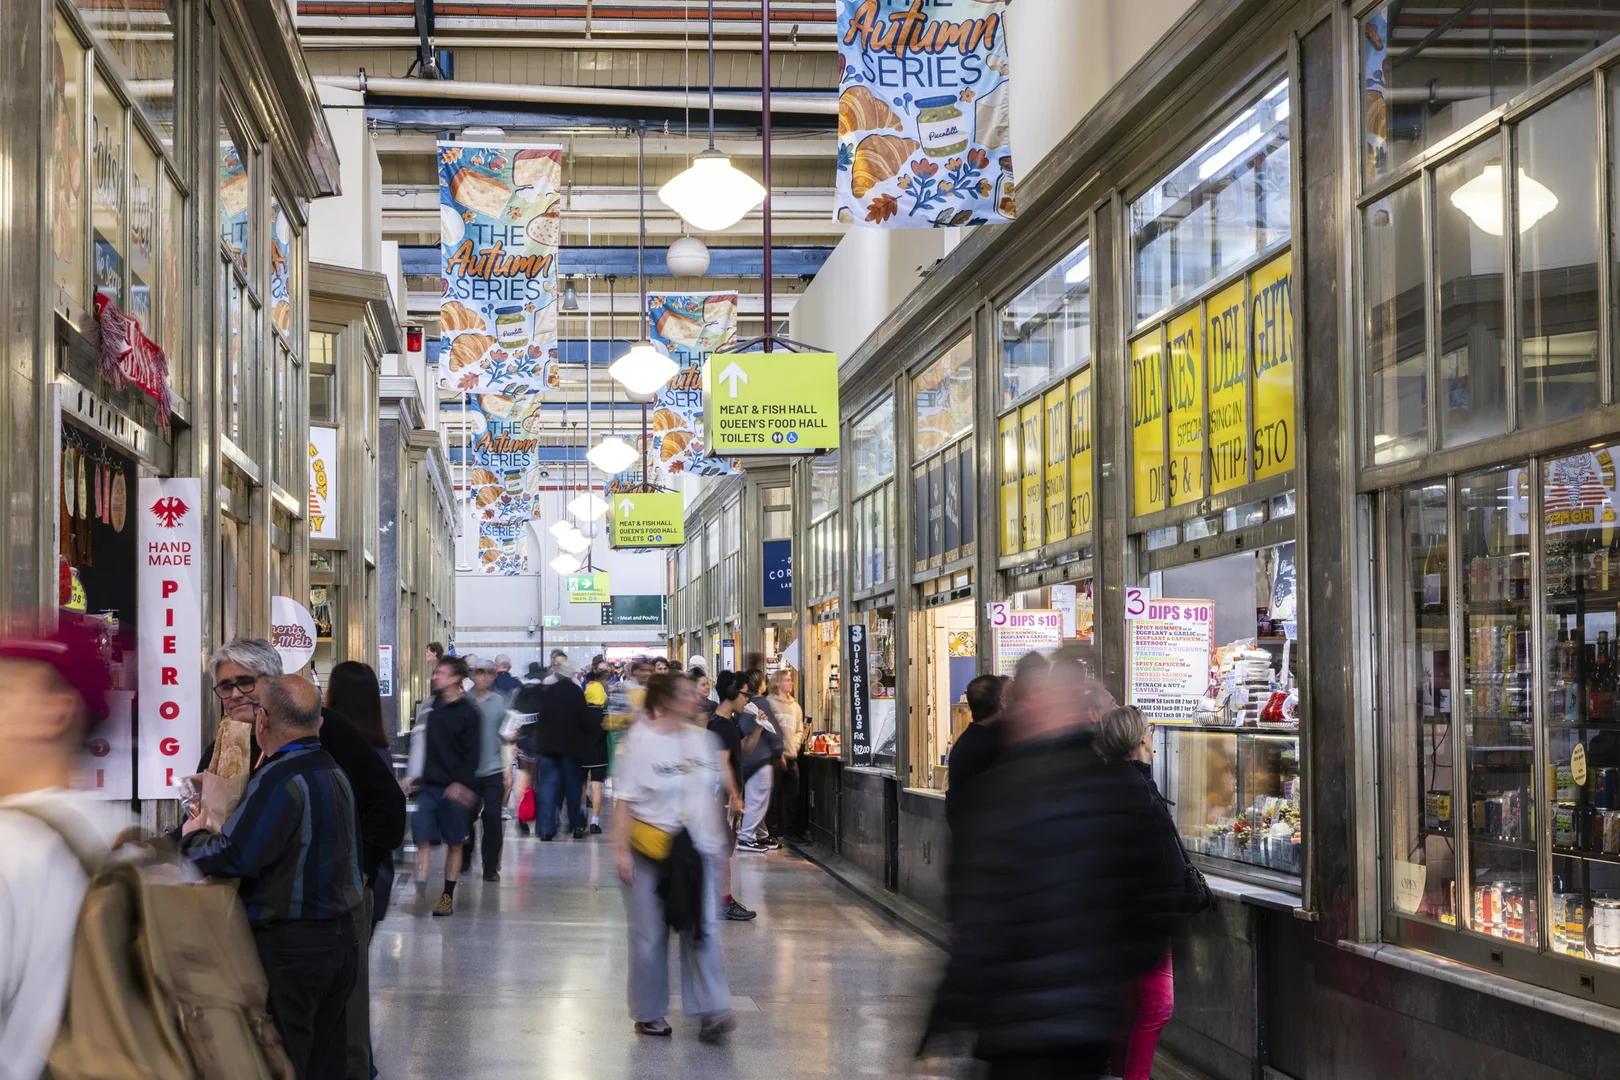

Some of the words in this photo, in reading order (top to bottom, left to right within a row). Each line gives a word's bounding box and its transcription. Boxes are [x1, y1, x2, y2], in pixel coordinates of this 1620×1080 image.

[843, 0, 999, 59] Autumn
[861, 52, 982, 88] SERIES
[472, 224, 524, 246] THE
[446, 239, 553, 281] Autumn
[456, 278, 541, 300] SERIES
[1211, 273, 1294, 394] DELGHT
[665, 391, 703, 408] SERI
[720, 405, 749, 415] MEAT
[751, 405, 760, 414] &
[762, 404, 786, 415] FISH
[789, 404, 817, 414] HALL
[490, 421, 521, 434] THE
[720, 419, 766, 430] QUEEN'S
[768, 419, 797, 429] FOOD
[799, 418, 828, 428] HALL
[474, 431, 537, 456] Autumn
[720, 433, 765, 443] TOILETS
[481, 453, 530, 467] SERIES
[313, 458, 327, 502] SOY
[1150, 459, 1178, 504] DIS
[1182, 456, 1192, 493] &
[485, 526, 521, 536] SERIES
[148, 541, 191, 553] HAND
[148, 554, 191, 566] MADE
[993, 603, 1007, 626] 3
[1010, 615, 1035, 626] DIPS
[1038, 615, 1057, 626] $10
[1127, 590, 1145, 616] 3
[1149, 605, 1180, 620] DIPS
[1184, 606, 1208, 621] $10
[279, 635, 313, 648] Melt
[852, 625, 863, 643] 3
[853, 644, 861, 673] DIPS
[159, 580, 180, 787] PIEROGI
[853, 683, 863, 730] PESTOS
[853, 732, 864, 740] FOR
